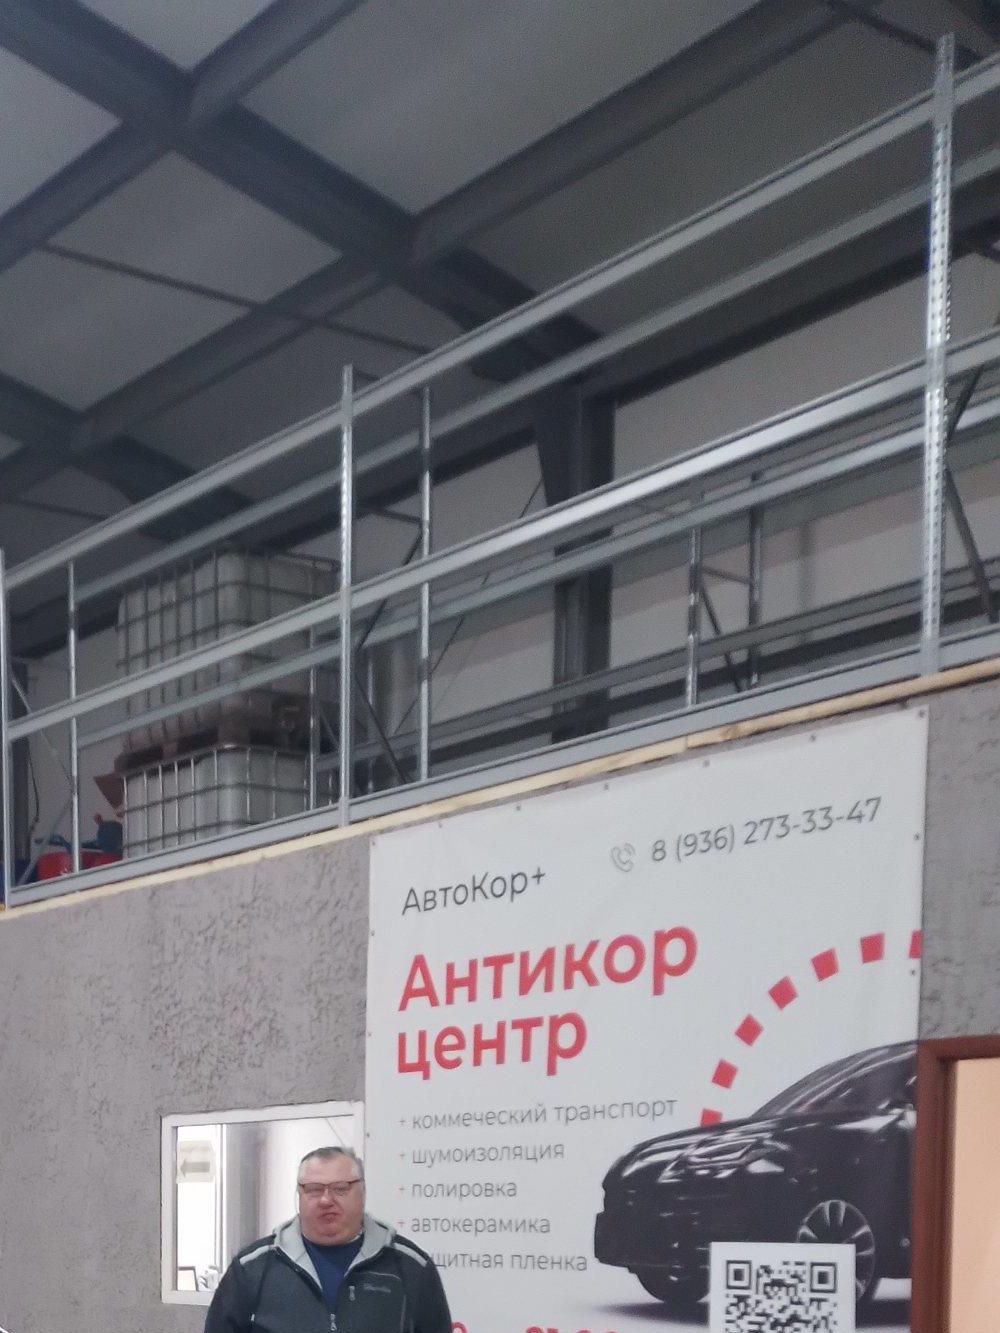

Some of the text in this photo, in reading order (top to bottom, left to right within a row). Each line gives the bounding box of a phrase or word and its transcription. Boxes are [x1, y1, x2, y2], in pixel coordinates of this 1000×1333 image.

[651, 796, 882, 863] 8 (936) 273-33-47
[401, 866, 547, 916] АвтоКор+
[397, 924, 699, 1012] Антикор
[396, 1011, 588, 1081] центр
[411, 1099, 678, 1130] коммеческий транспорт
[411, 1143, 565, 1168] шумоизоляция
[411, 1180, 518, 1201] полировка
[410, 1215, 551, 1237] автокерамика
[432, 1253, 588, 1272] щитная пленка
